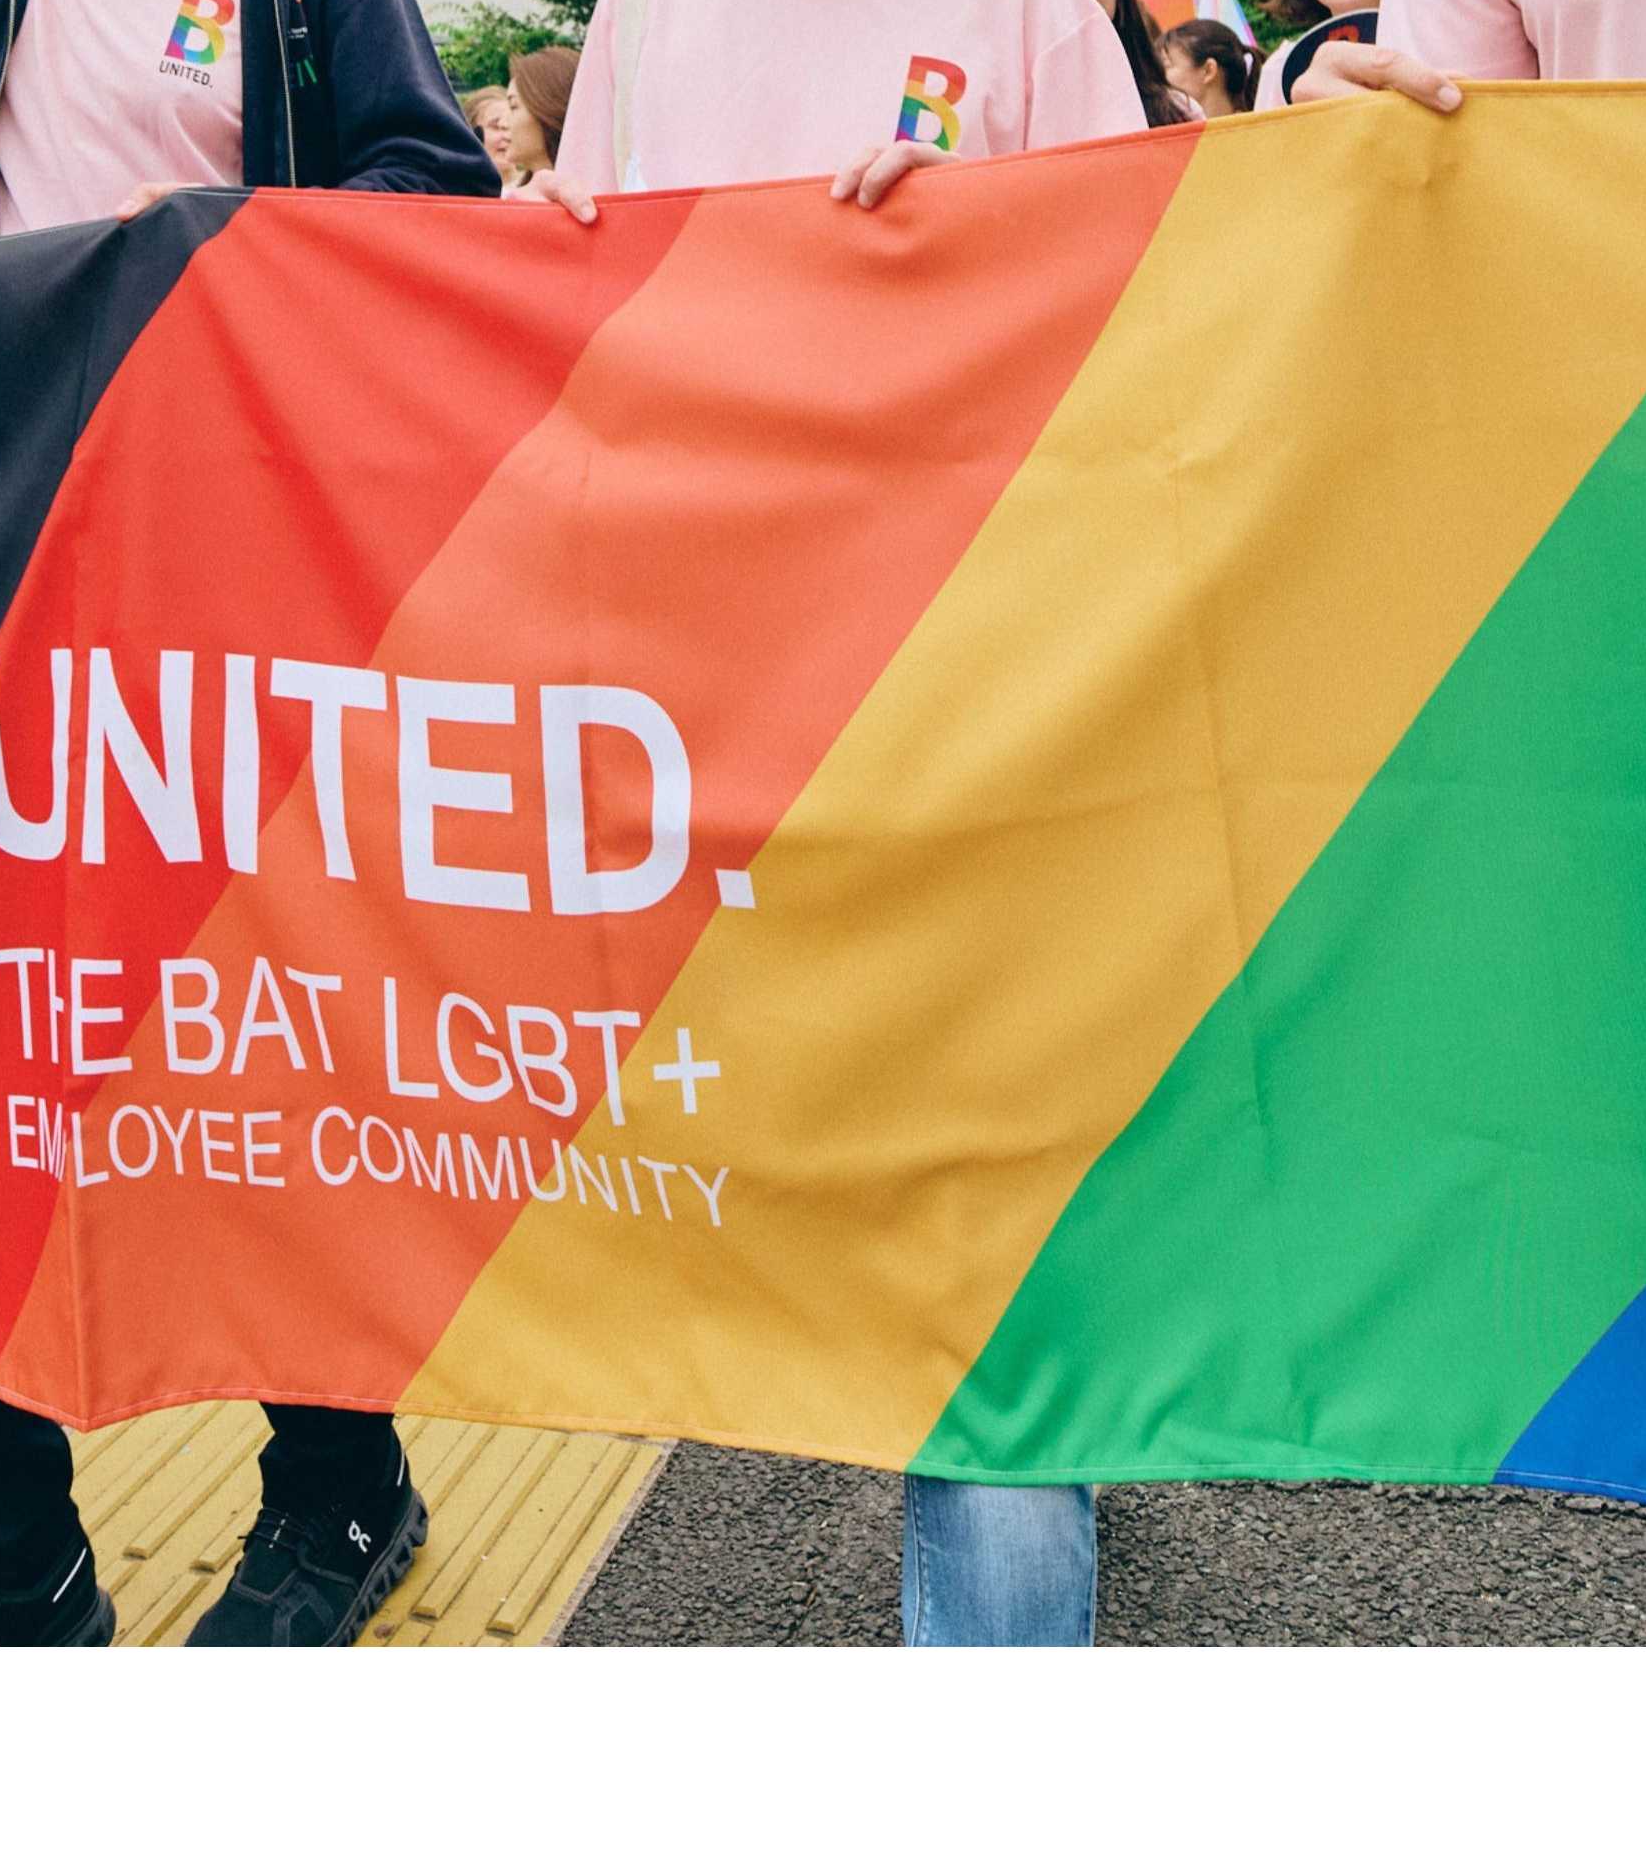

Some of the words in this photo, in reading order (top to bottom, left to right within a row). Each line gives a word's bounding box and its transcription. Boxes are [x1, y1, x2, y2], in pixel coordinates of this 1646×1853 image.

[158, 60, 214, 88] UNITED.
[895, 55, 967, 151] B
[159, 956, 343, 1075] BAT
[383, 976, 721, 1127] LGBT+
[8, 1094, 287, 1188] EMLOYEE
[310, 1106, 731, 1228] COMMUNITY
